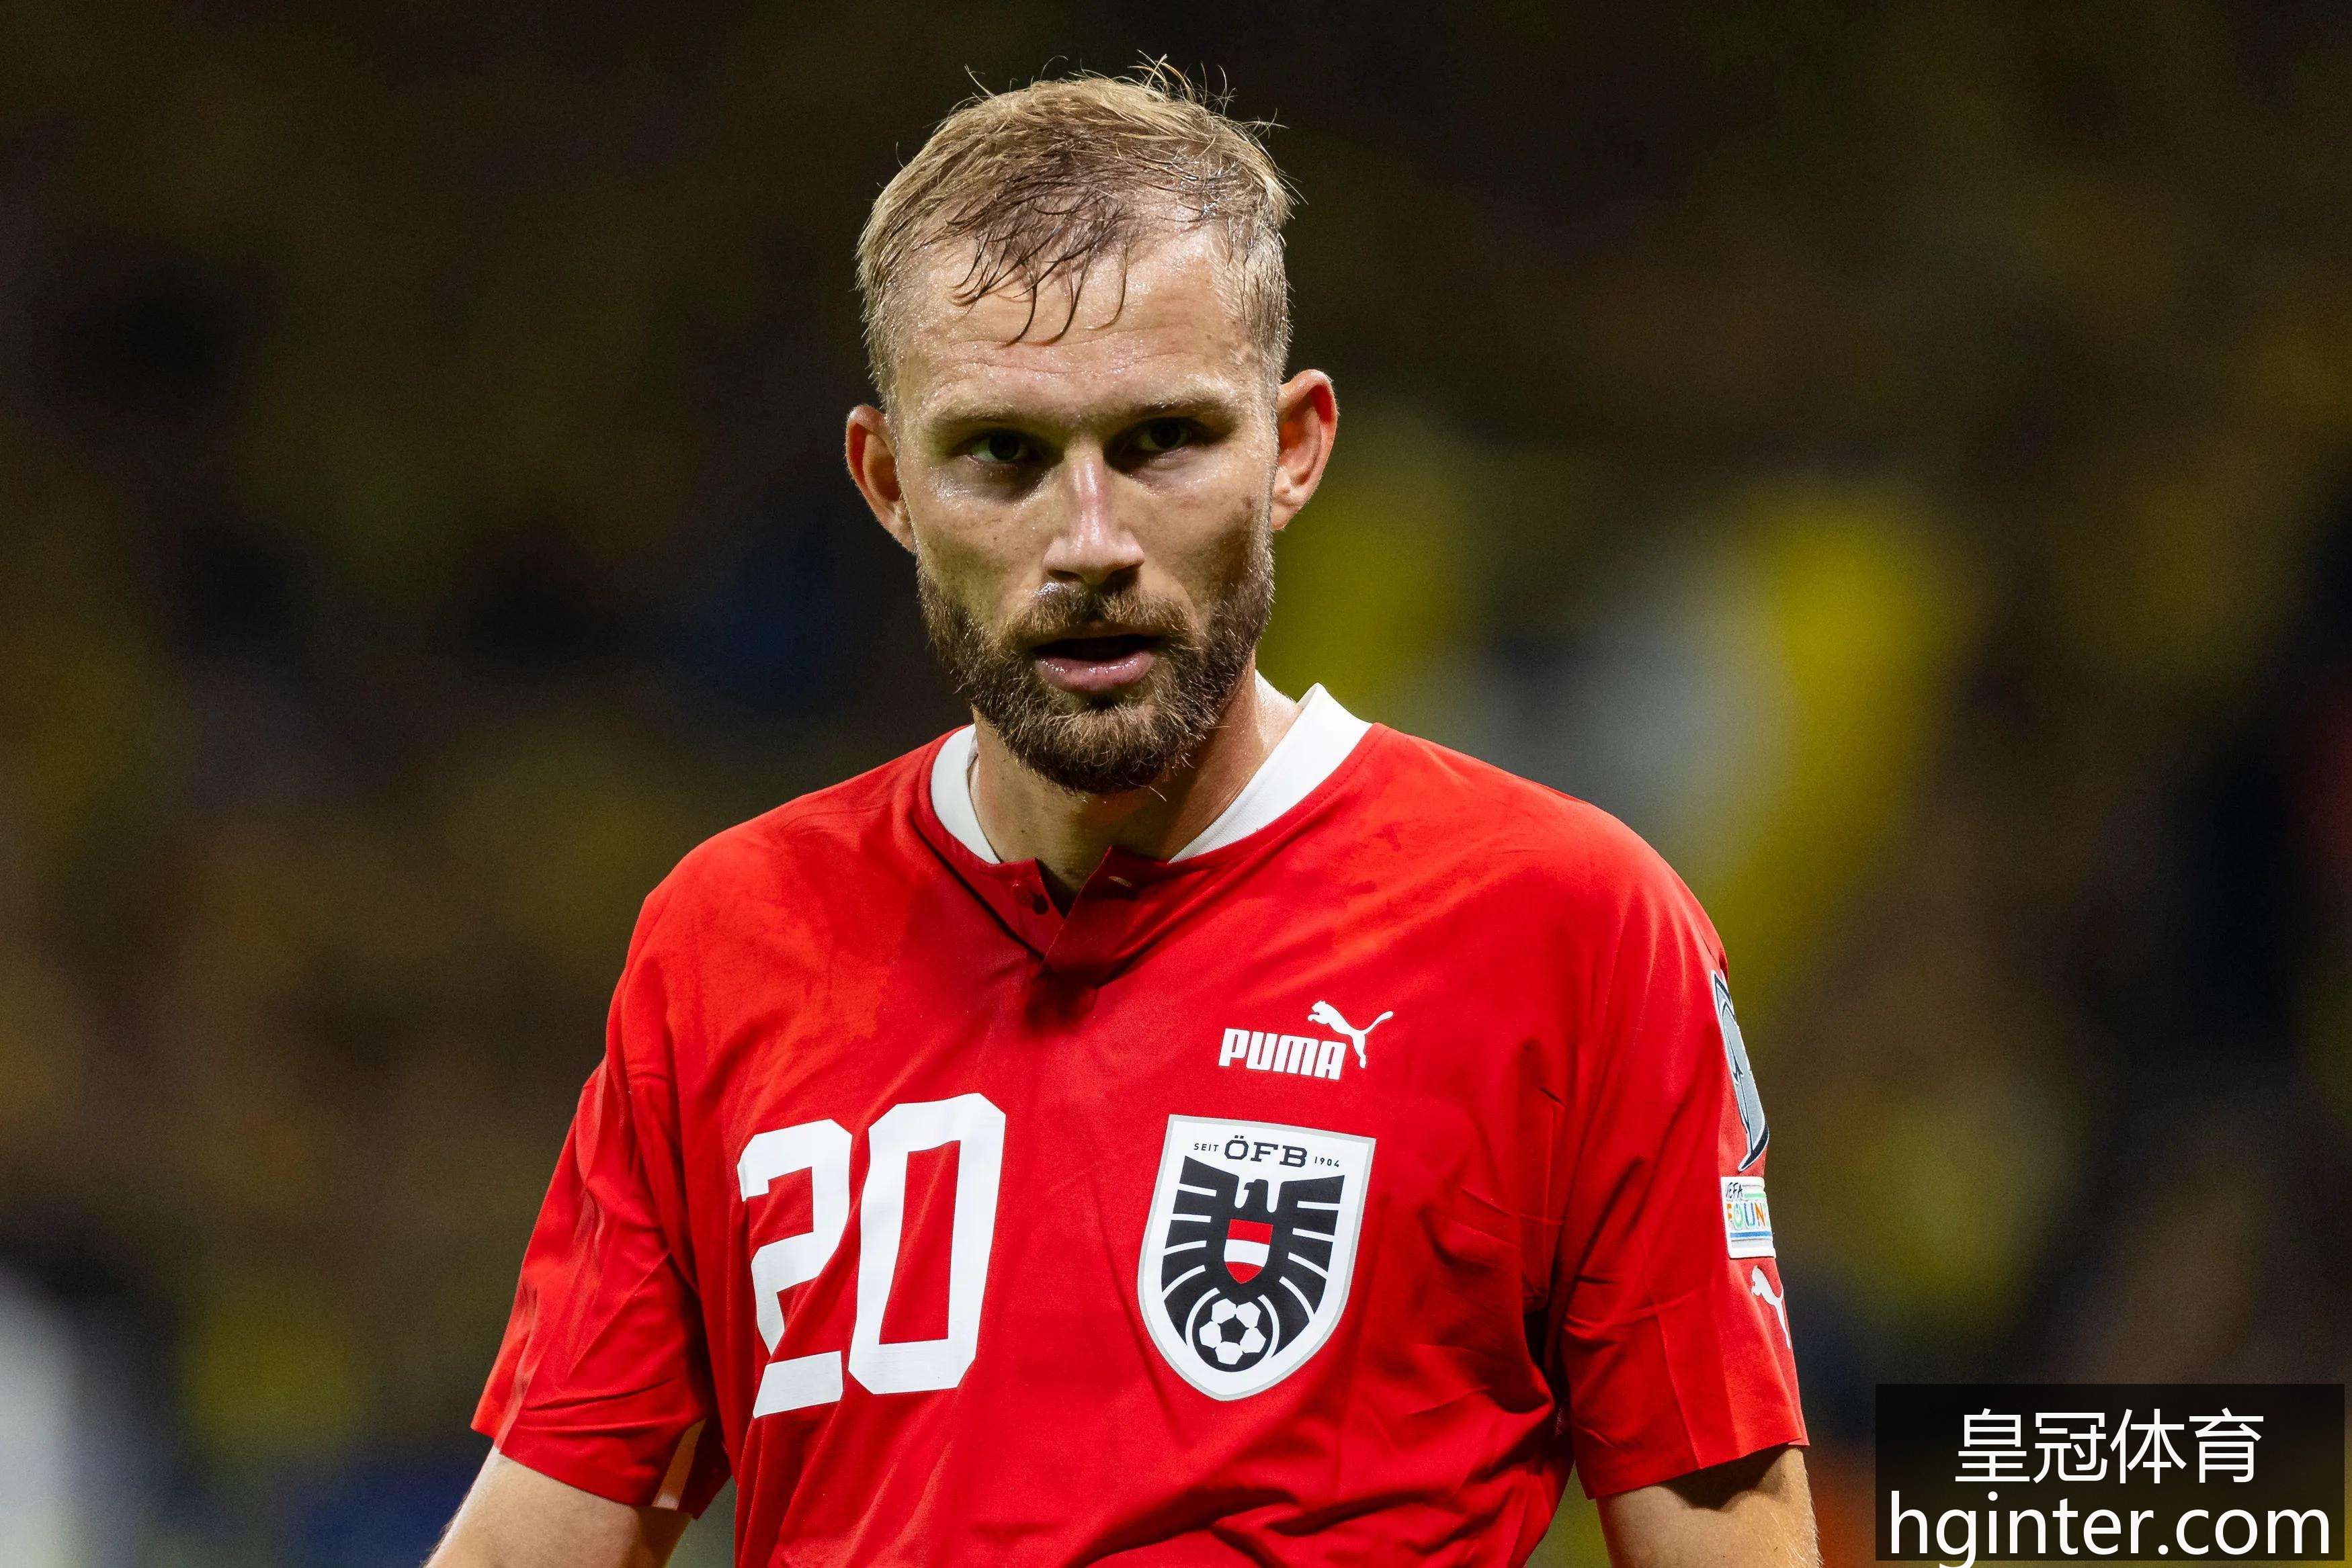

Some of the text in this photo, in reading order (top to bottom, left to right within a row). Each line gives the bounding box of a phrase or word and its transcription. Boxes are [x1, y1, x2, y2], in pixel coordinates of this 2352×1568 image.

[1218, 1027, 1347, 1081] PUMA
[1193, 1135, 1340, 1168] SEIT ÖFB 1904
[737, 1092, 1007, 1419] 20
